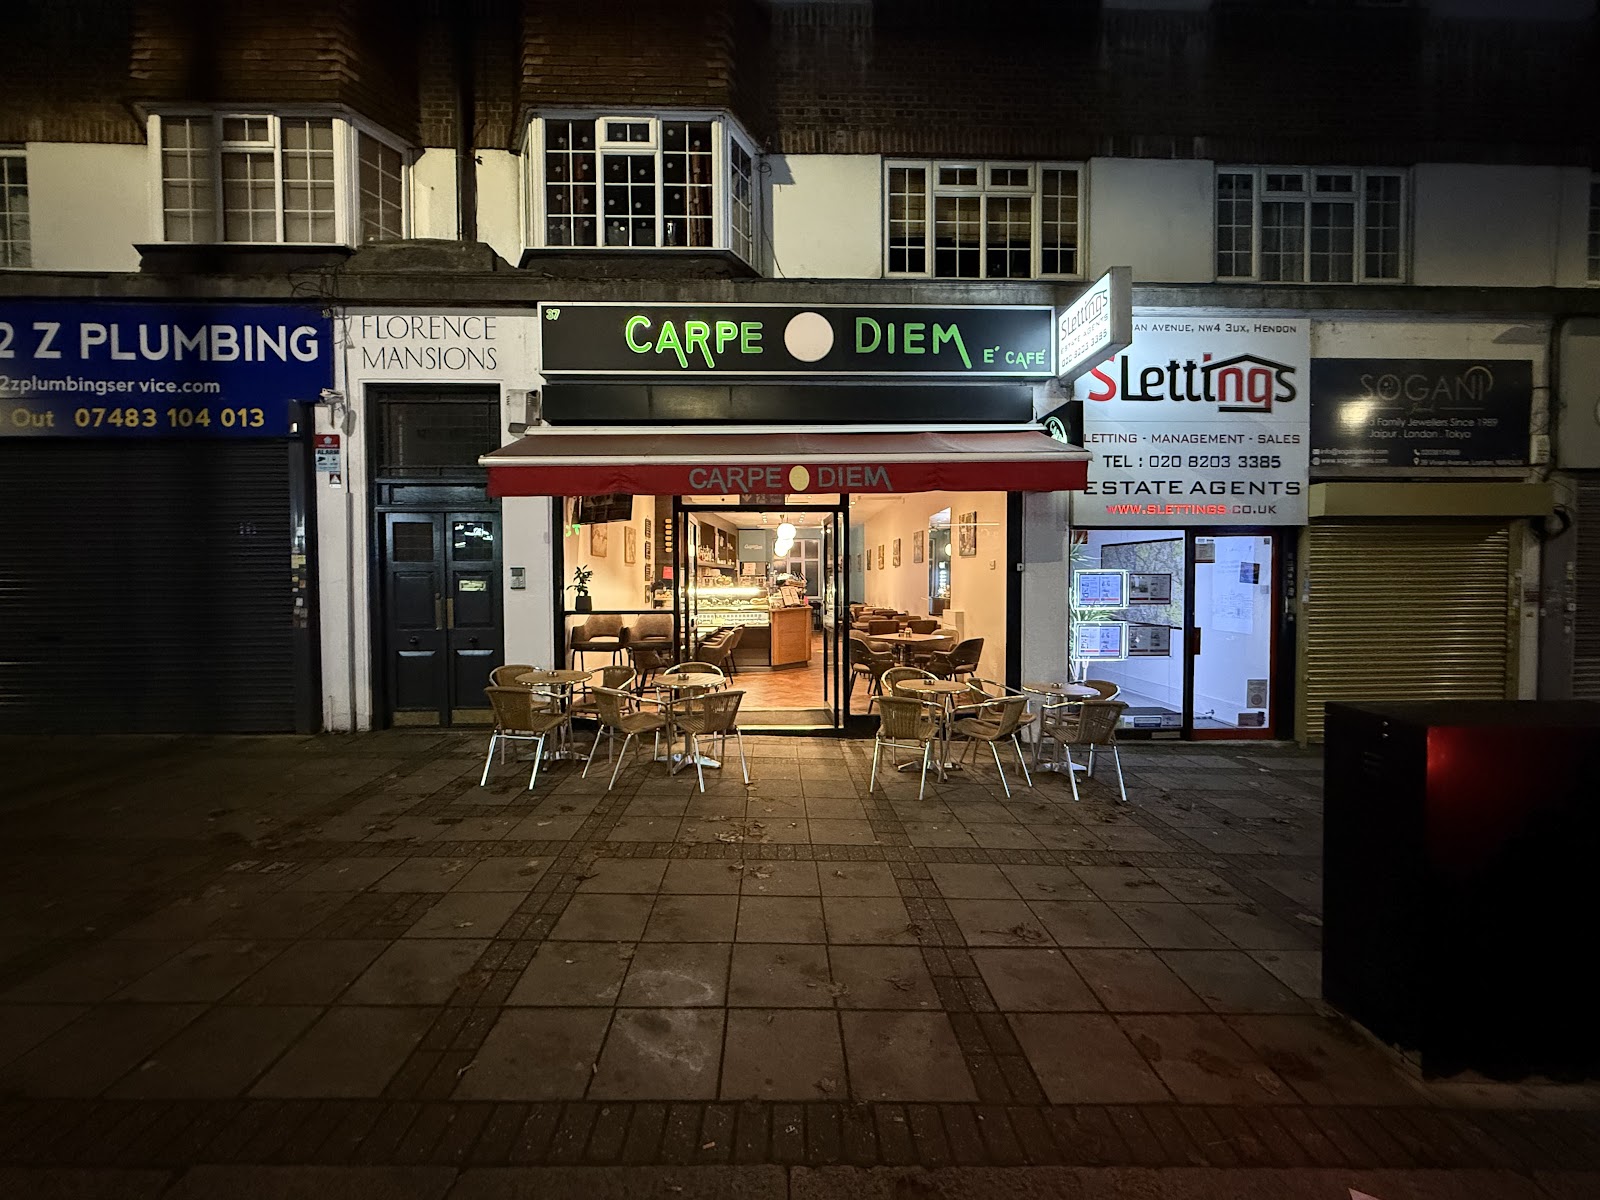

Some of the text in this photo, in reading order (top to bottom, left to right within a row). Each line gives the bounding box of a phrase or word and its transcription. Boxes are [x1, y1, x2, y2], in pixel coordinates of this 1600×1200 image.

[546, 308, 560, 320] 37
[362, 315, 497, 340] FLORENCE
[1152, 323, 1194, 333] AVENUE,
[33, 321, 62, 358] Z
[80, 322, 319, 362] PLUMBING
[625, 315, 972, 369] CARPE DIEM
[362, 346, 498, 371] MANSIONS
[1360, 369, 1486, 401] SOGANI
[11, 407, 265, 428] Out 07483 104 013
[1084, 434, 1137, 443] LETTING
[1151, 434, 1243, 444] MANAGEMENT
[1258, 434, 1300, 444] SALES
[1103, 455, 1132, 468] TEL
[1149, 455, 1181, 468] 020
[1189, 455, 1230, 468] 8203
[1238, 455, 1281, 468] 3385
[689, 465, 893, 493] CARPE DIEM
[1084, 481, 1300, 495] ESTATE AGENTS
